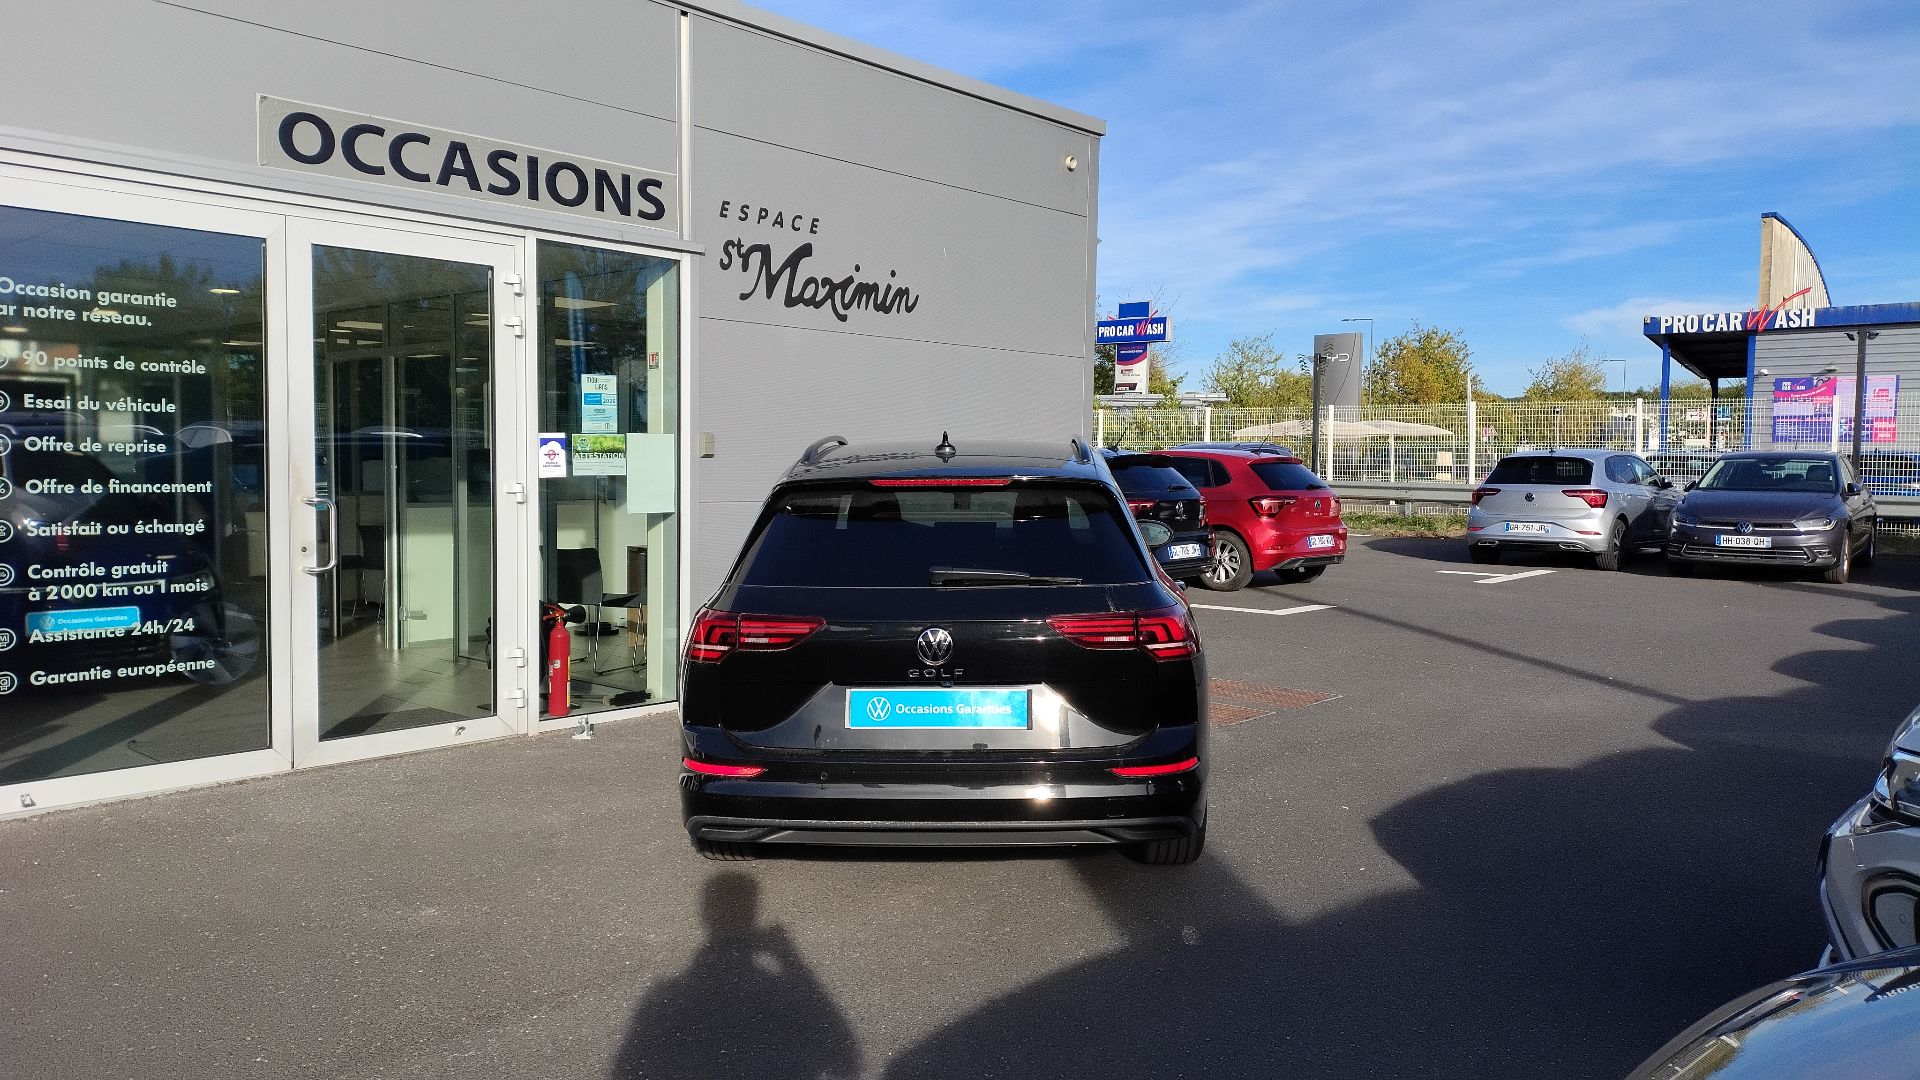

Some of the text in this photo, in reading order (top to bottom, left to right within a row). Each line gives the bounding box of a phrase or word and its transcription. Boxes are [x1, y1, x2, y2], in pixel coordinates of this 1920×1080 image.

[278, 111, 666, 221] OCCASIONS
[719, 200, 819, 235] ESPACE
[719, 237, 919, 322] St Maximin
[0, 277, 177, 308] Occasion garantie
[23, 304, 76, 321] notre
[82, 307, 152, 327] réseau.
[1660, 287, 1816, 334] PRO CAR WASH
[1098, 309, 1164, 338] PRO CAR WASH
[22, 350, 206, 374] 90 points de contrôle
[24, 393, 176, 413] Essai du véhicule
[24, 436, 167, 455] Offre de reprise
[25, 478, 212, 494] Offre de financement
[26, 518, 205, 537] Satisfait ou échangé
[28, 560, 168, 580] Contrôle gratuit
[28, 586, 41, 601] à
[102, 582, 128, 597] km
[133, 584, 154, 595] ou
[159, 579, 166, 593] 1
[170, 578, 209, 593] mois
[29, 618, 195, 644] Assistance 24h/24
[30, 658, 216, 686] Garantie européenne
[908, 668, 964, 678] GOLF
[895, 703, 953, 715] Occasions
[955, 703, 1012, 715] Garanties
